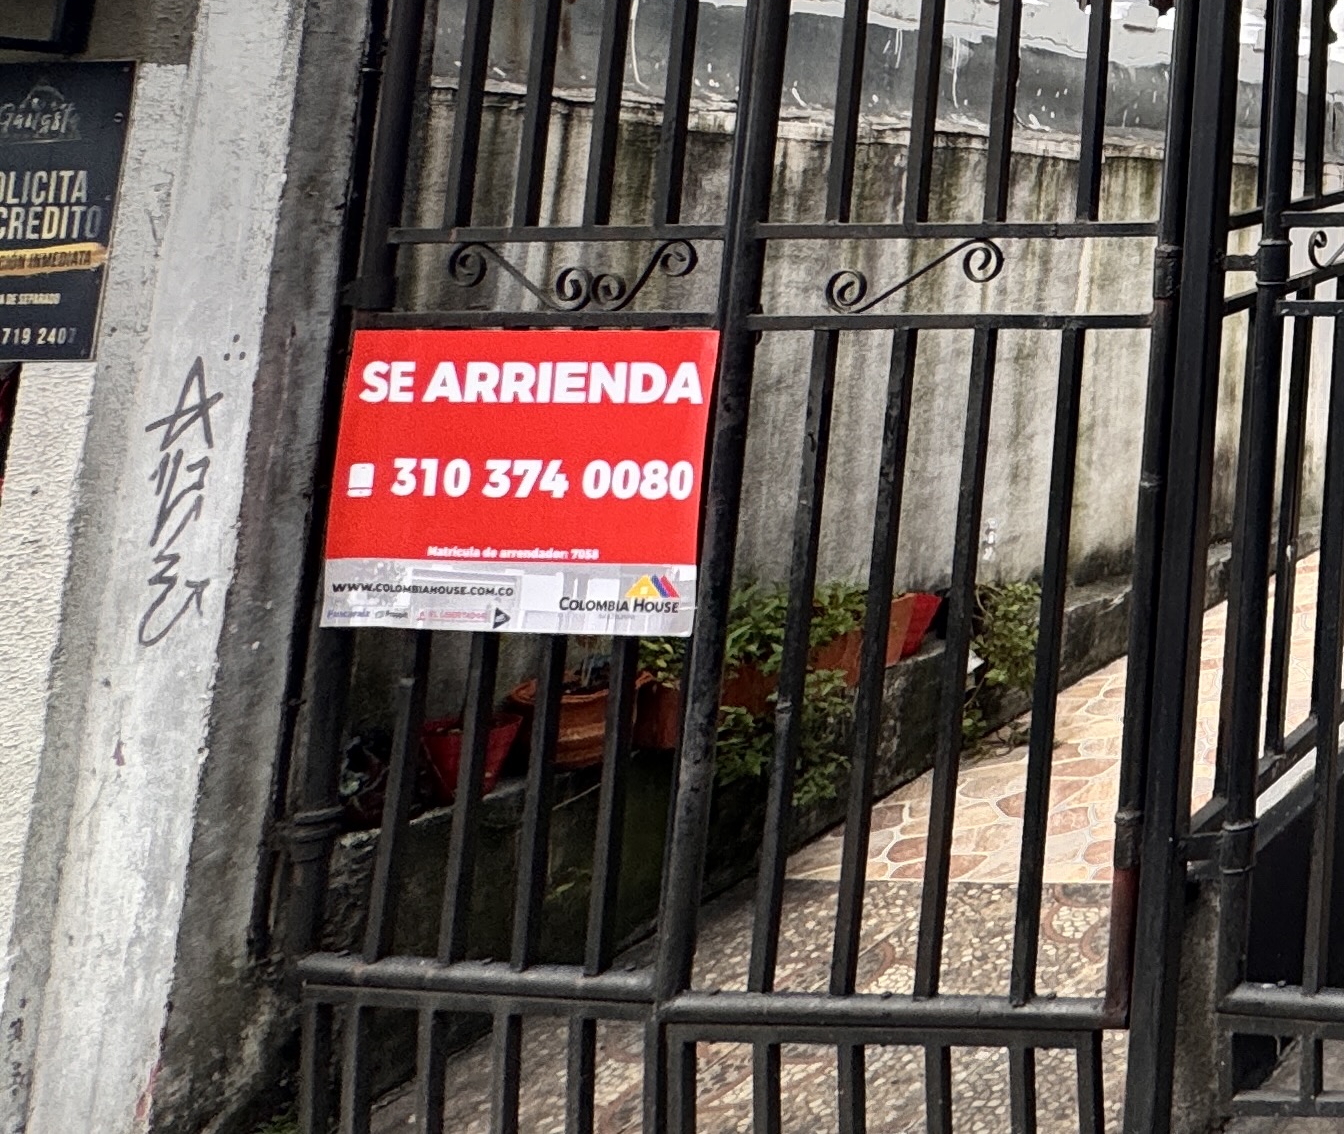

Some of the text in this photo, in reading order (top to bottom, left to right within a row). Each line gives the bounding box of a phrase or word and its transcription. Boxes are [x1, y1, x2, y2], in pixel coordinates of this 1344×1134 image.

[1, 327, 31, 345] 719
[359, 361, 703, 404] SE ARRIENDA
[390, 458, 694, 500] 310 374 0080
[332, 583, 514, 597] WWW.COLOMBIAHOUSE.COM.CO
[559, 596, 679, 613] COLOMBIA HOUSE
